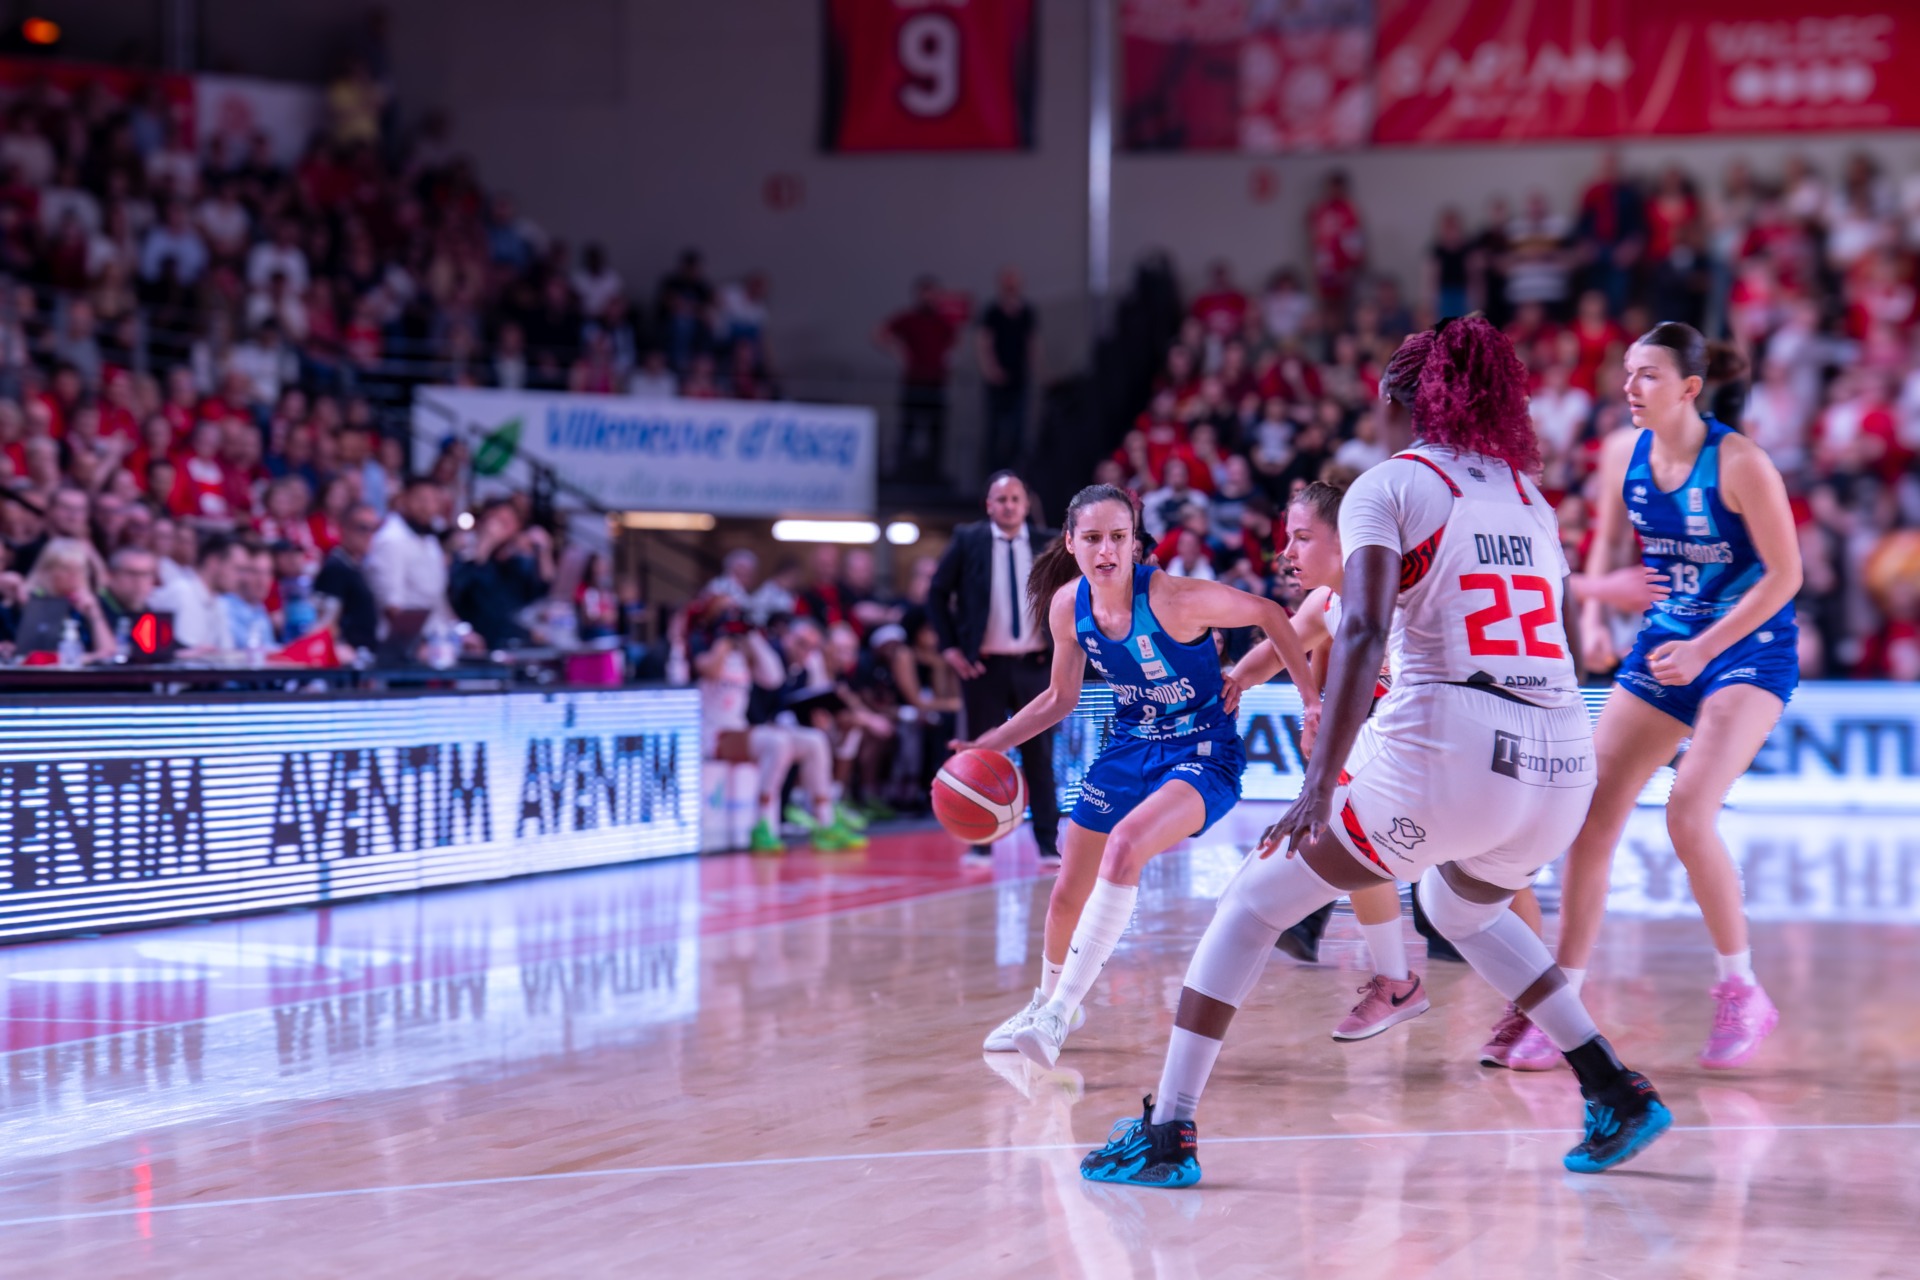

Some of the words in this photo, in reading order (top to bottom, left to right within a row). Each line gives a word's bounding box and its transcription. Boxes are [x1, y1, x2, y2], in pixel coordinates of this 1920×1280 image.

[898, 14, 958, 117] 9
[545, 405, 727, 456] Villeneuve
[1474, 533, 1534, 567] DIABY
[1669, 563, 1699, 594] 13
[1459, 573, 1566, 660] 22
[1504, 675, 1547, 687] ADIM
[268, 742, 492, 866] AVENTIM
[516, 733, 682, 838] AVENTIM
